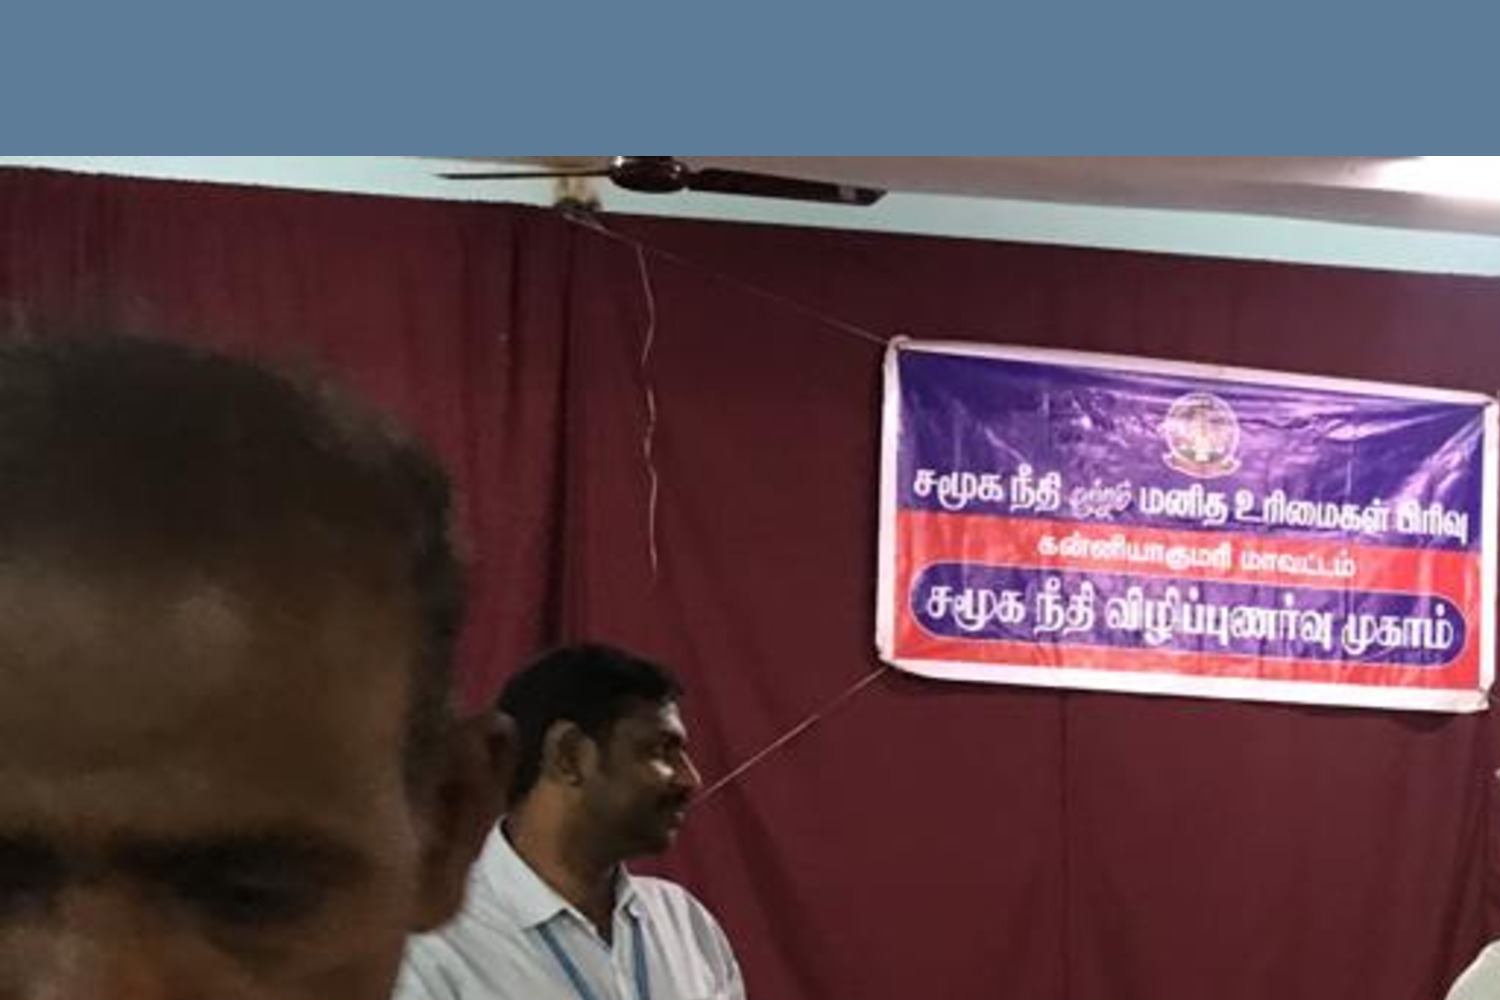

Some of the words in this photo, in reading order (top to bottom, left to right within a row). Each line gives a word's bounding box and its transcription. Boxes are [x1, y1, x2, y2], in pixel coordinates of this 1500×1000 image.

[913, 468, 1004, 510] சமூக
[1009, 463, 1062, 512] நீதி
[1140, 483, 1228, 526] மனித
[1235, 489, 1391, 535] உரிமைகள்
[1396, 500, 1469, 546] பிரிவு
[1037, 532, 1232, 570] கன்னியாகுமரி
[1240, 549, 1356, 577] மாவட்டம்
[926, 585, 1026, 631] சமூக
[1033, 576, 1096, 635] நீதி
[1105, 586, 1334, 651] விழிப்புணர்வு
[1341, 603, 1453, 656] முகாம்
